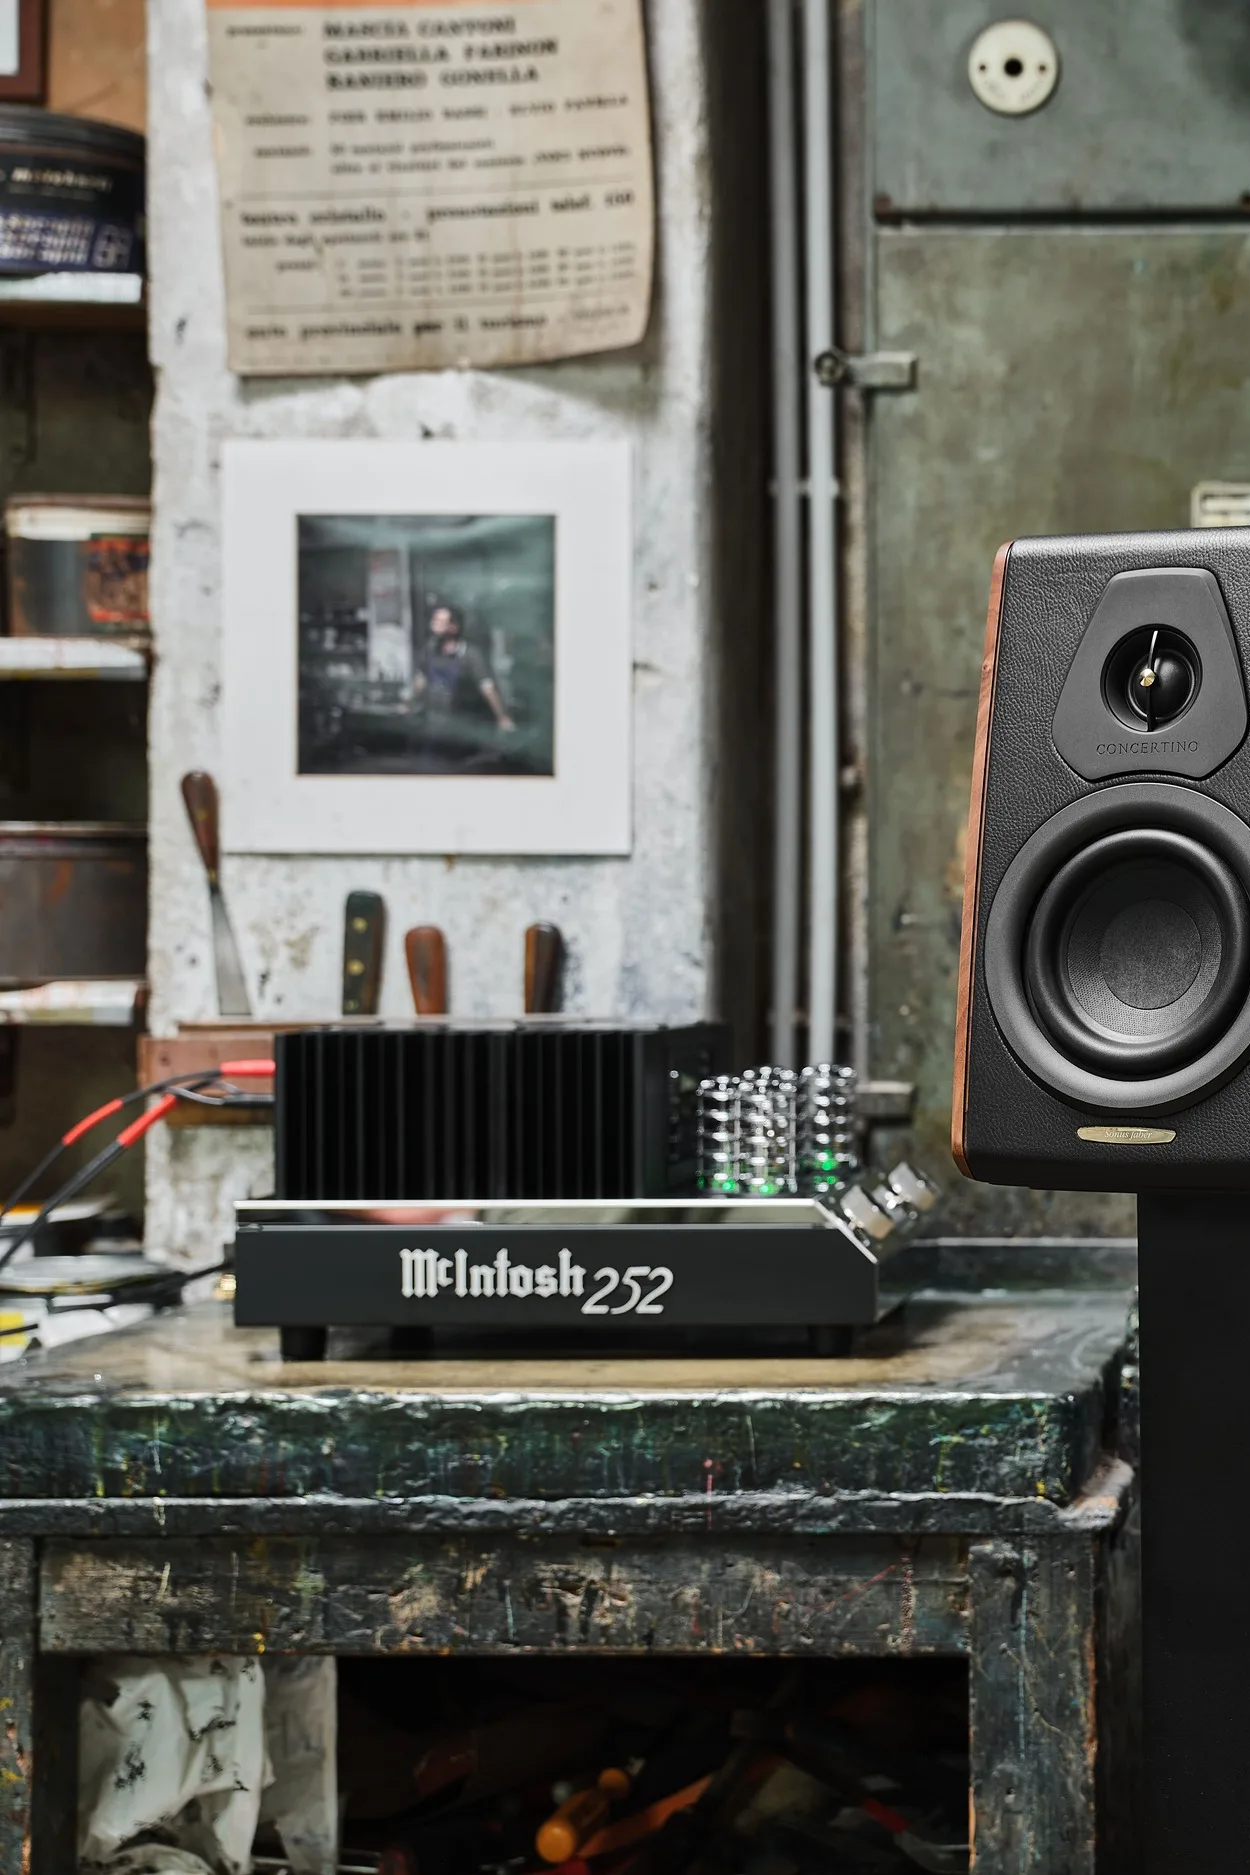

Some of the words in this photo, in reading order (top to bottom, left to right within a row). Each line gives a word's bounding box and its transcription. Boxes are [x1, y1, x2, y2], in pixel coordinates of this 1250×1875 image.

[1096, 740, 1199, 755] CONCERTINO
[1104, 1130, 1129, 1138] Sonus
[399, 1248, 587, 1298] McIntosh
[581, 1266, 674, 1315] 252
